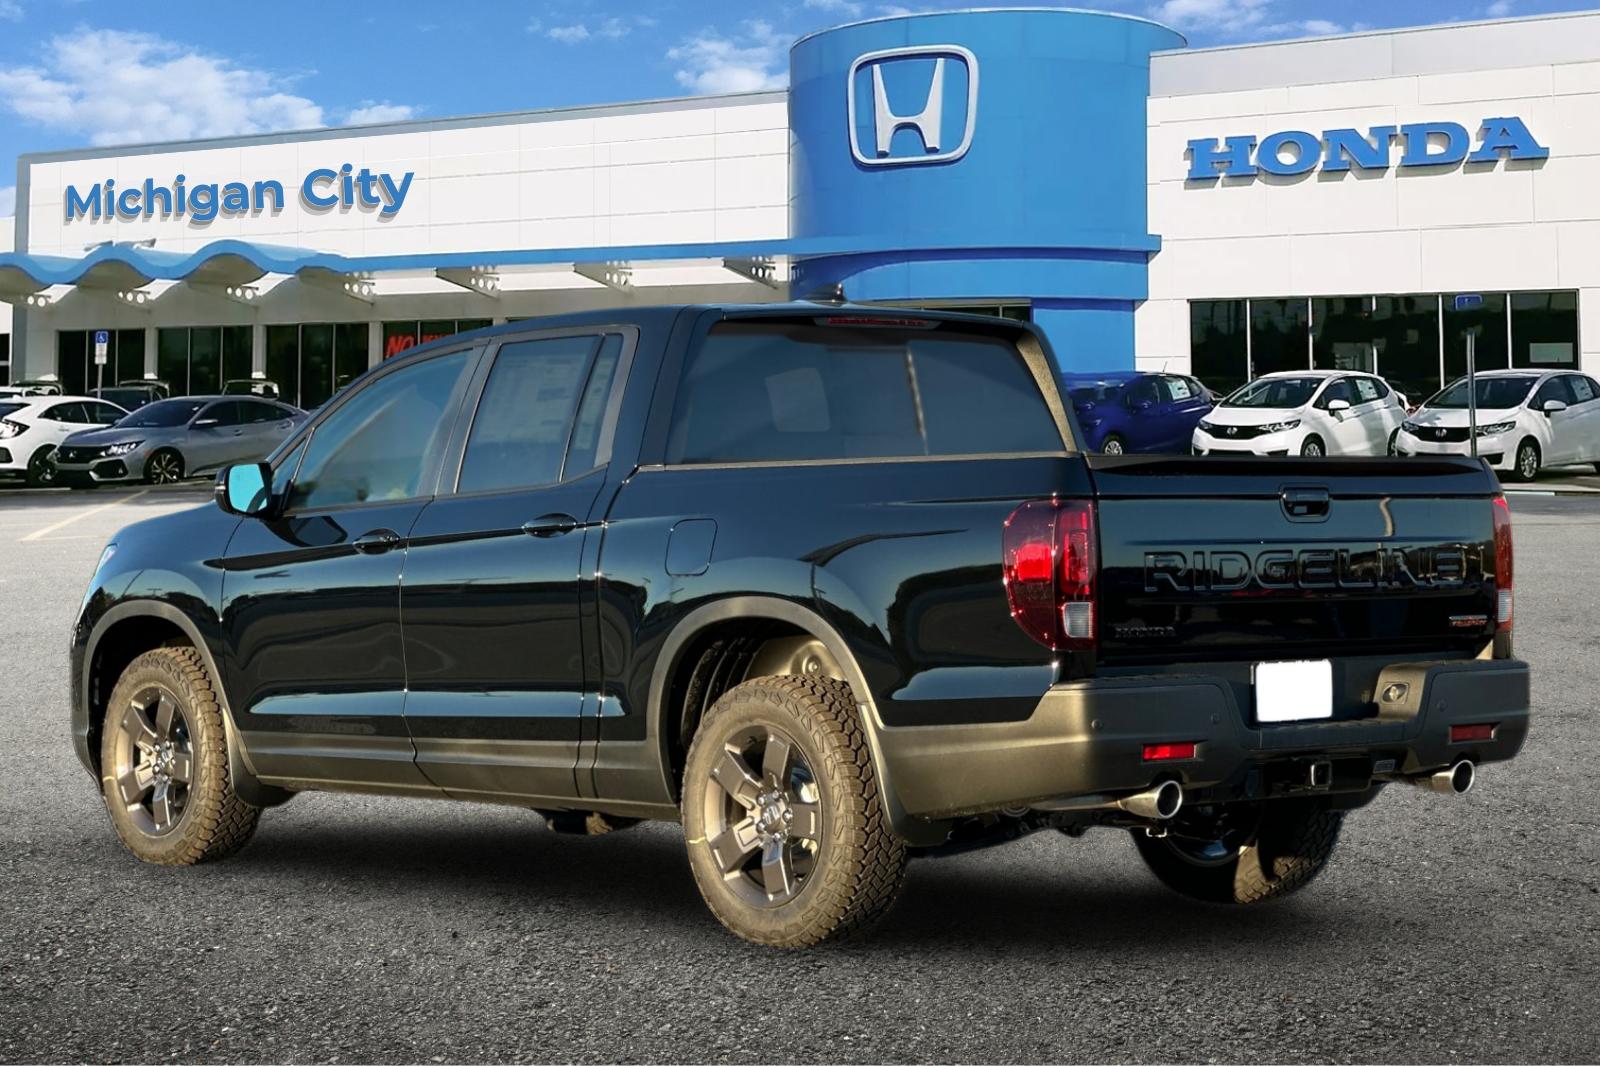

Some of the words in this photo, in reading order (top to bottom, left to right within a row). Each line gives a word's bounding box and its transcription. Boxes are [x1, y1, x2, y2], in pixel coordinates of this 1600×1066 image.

[1185, 117, 1550, 184] HONDA
[65, 174, 285, 222] Michigan
[302, 163, 415, 216] City
[1143, 547, 1468, 592] RIDGELINE
